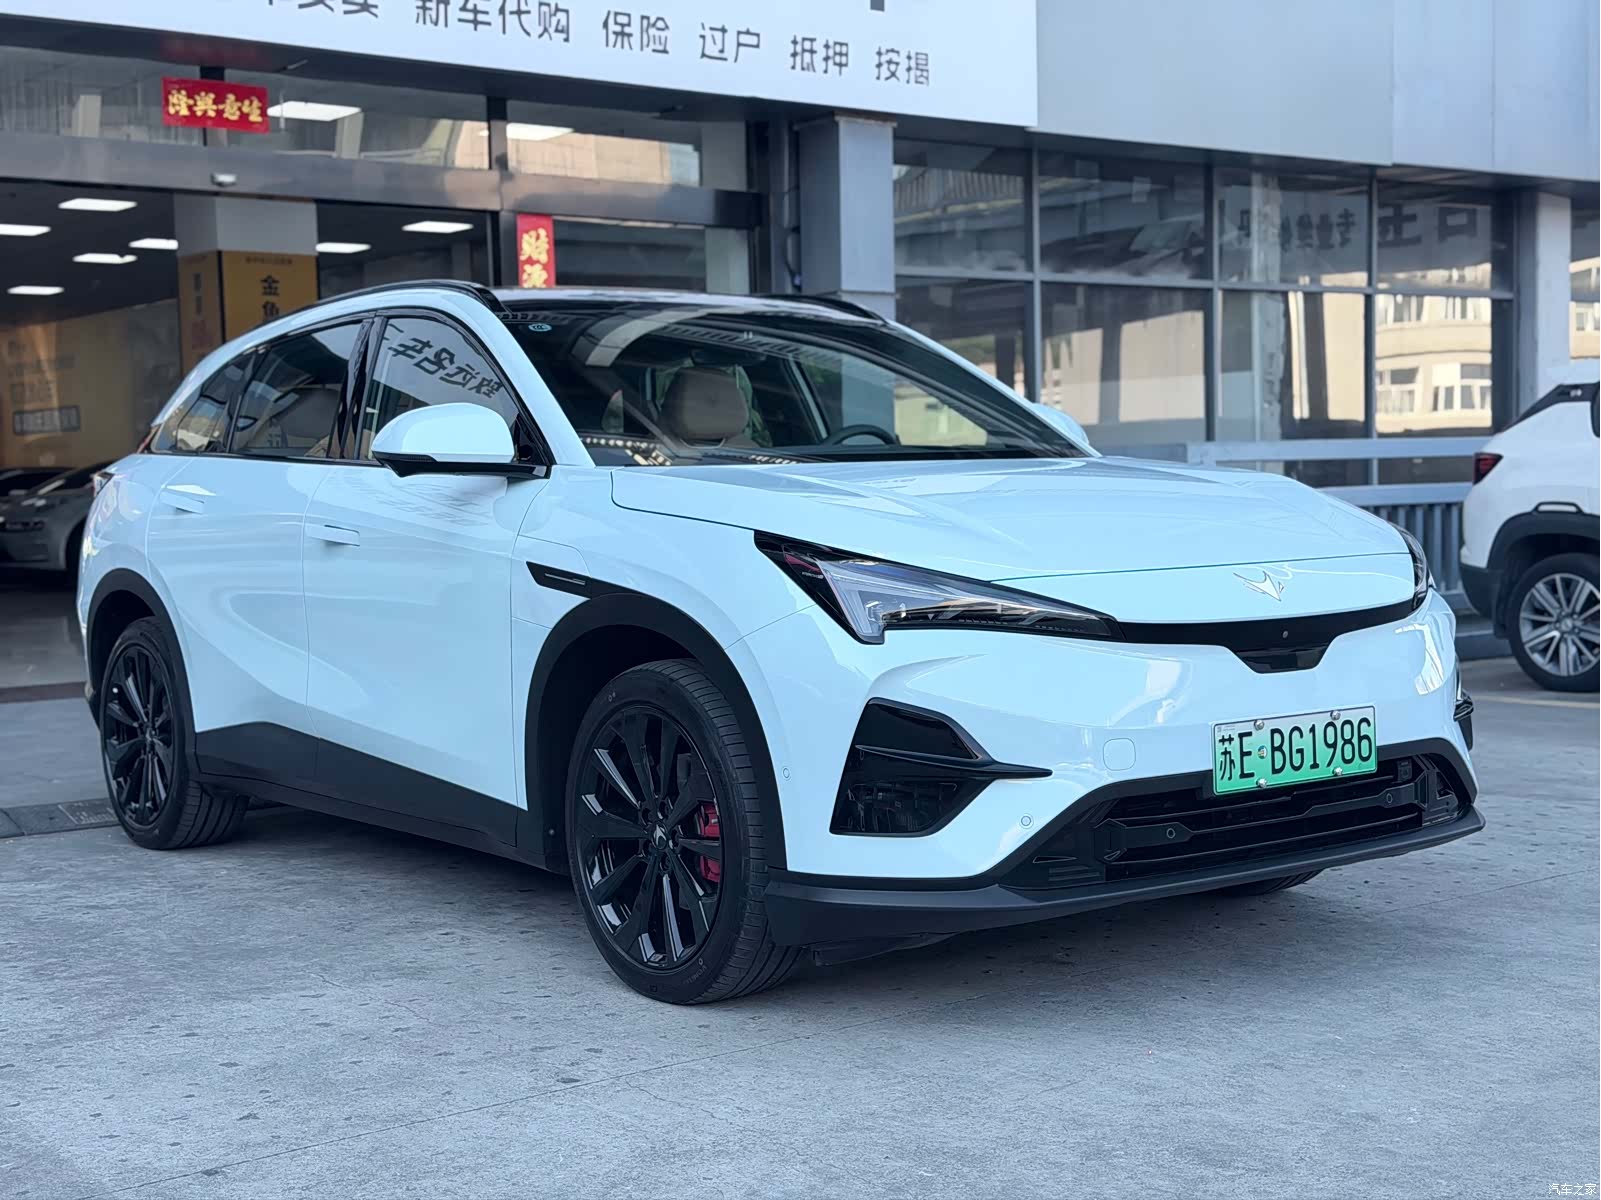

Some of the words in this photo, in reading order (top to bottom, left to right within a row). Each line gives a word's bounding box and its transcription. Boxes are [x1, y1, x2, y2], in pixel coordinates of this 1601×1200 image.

[415, 0, 570, 43] 新车代购
[602, 9, 670, 55] 保险
[699, 22, 761, 63] 过户
[790, 34, 849, 77] 抵押
[875, 46, 930, 87] 按揭
